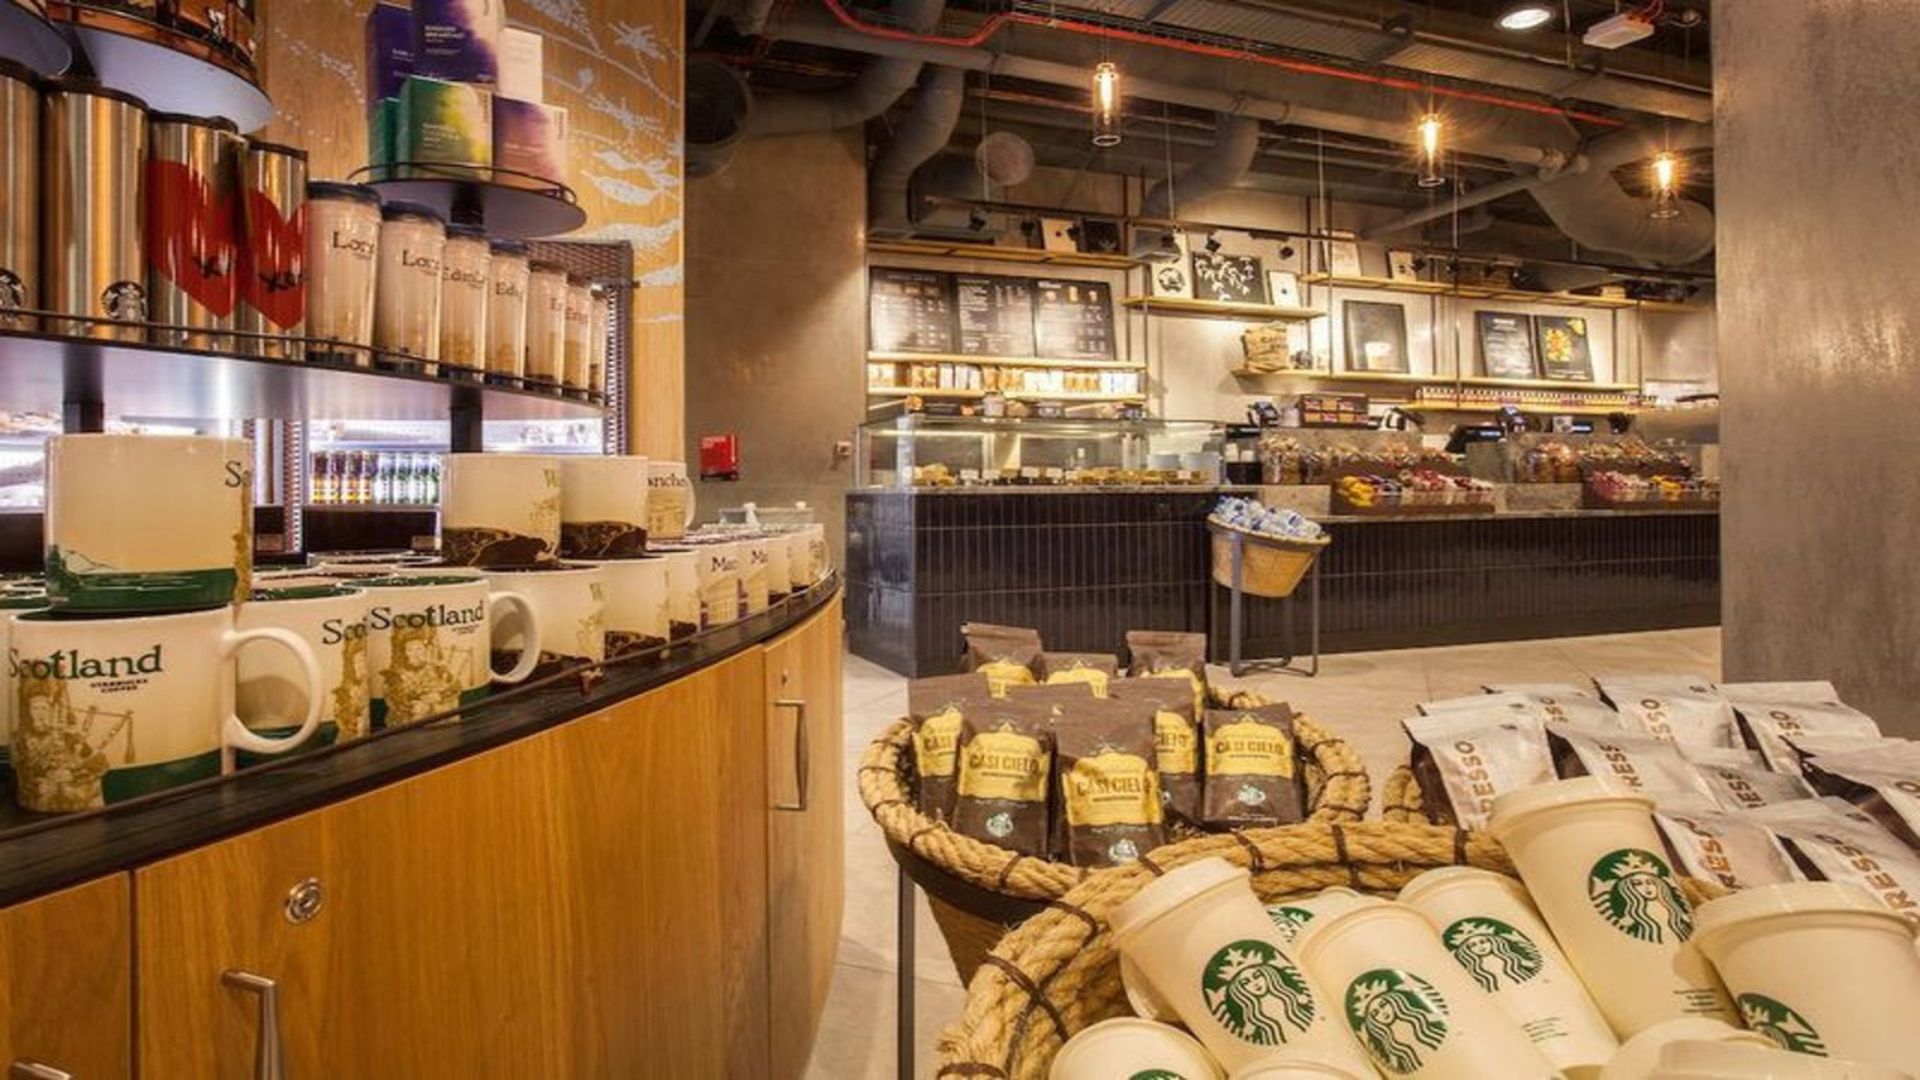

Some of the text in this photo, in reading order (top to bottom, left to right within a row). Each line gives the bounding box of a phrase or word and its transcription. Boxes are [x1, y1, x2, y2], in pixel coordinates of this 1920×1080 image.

[371, 599, 485, 630] Scotland
[322, 617, 369, 646] Sco
[8, 644, 163, 680] Scotland
[1215, 740, 1286, 756] CASI CIELO
[969, 754, 1040, 775] CASI CIELO
[1077, 777, 1110, 797] CASI
